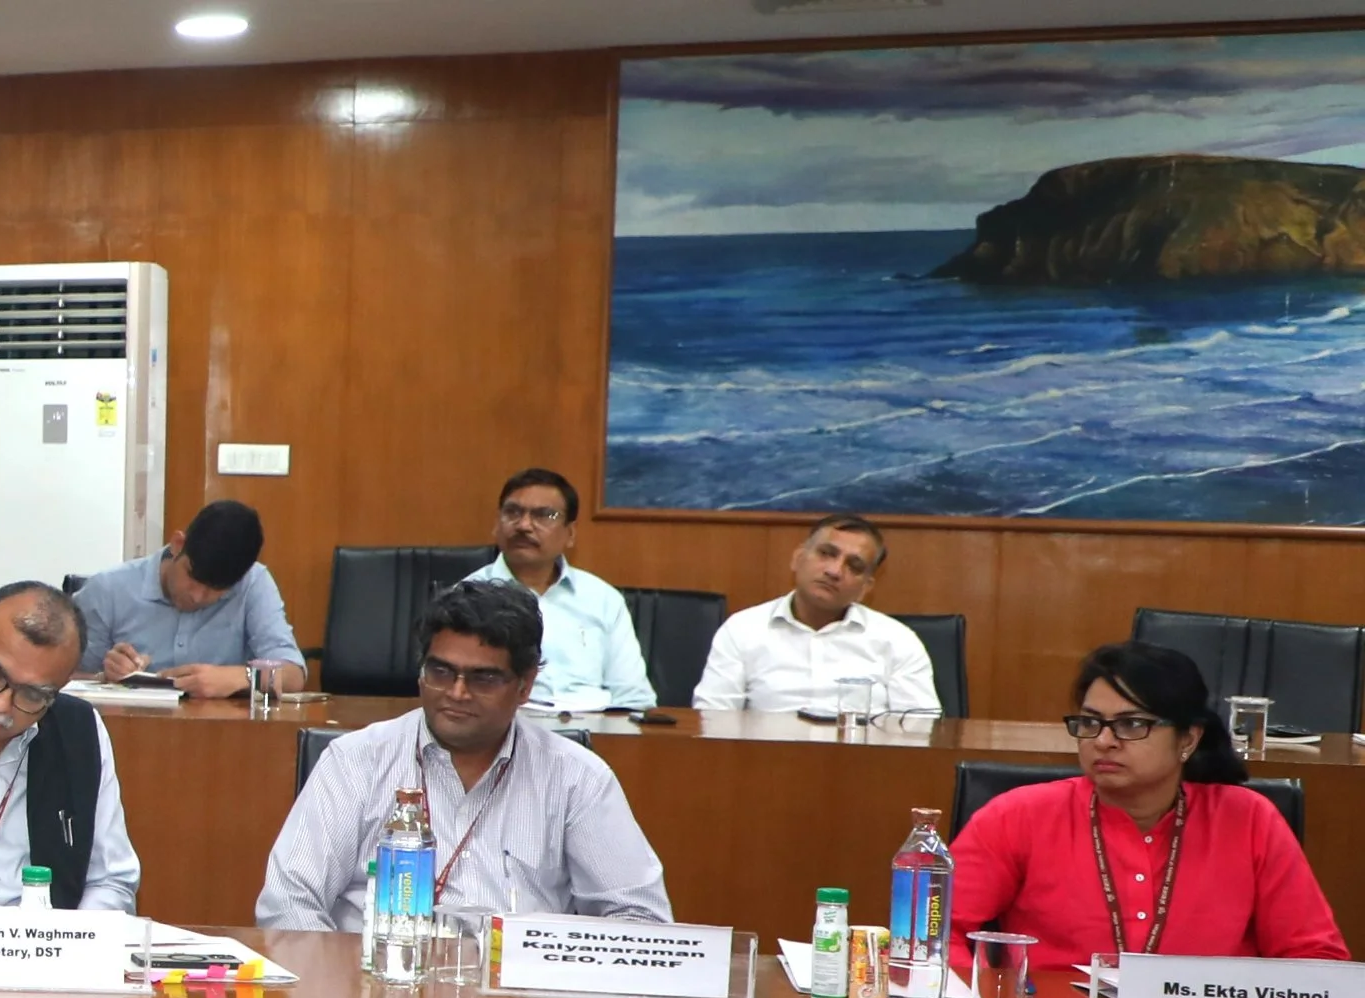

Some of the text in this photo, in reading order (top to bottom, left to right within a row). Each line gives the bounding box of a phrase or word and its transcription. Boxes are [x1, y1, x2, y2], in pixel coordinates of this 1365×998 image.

[929, 895, 942, 937] vedica
[9, 928, 21, 939] V.
[25, 928, 96, 941] Waghmare
[526, 929, 703, 946] Dr. Shivkumar
[35, 947, 62, 958] DST
[522, 941, 705, 958] Kalyanaraman
[543, 954, 683, 969] CEO, ANRF
[1163, 981, 1197, 996] Ms.
[1203, 984, 1248, 998] Ekta
